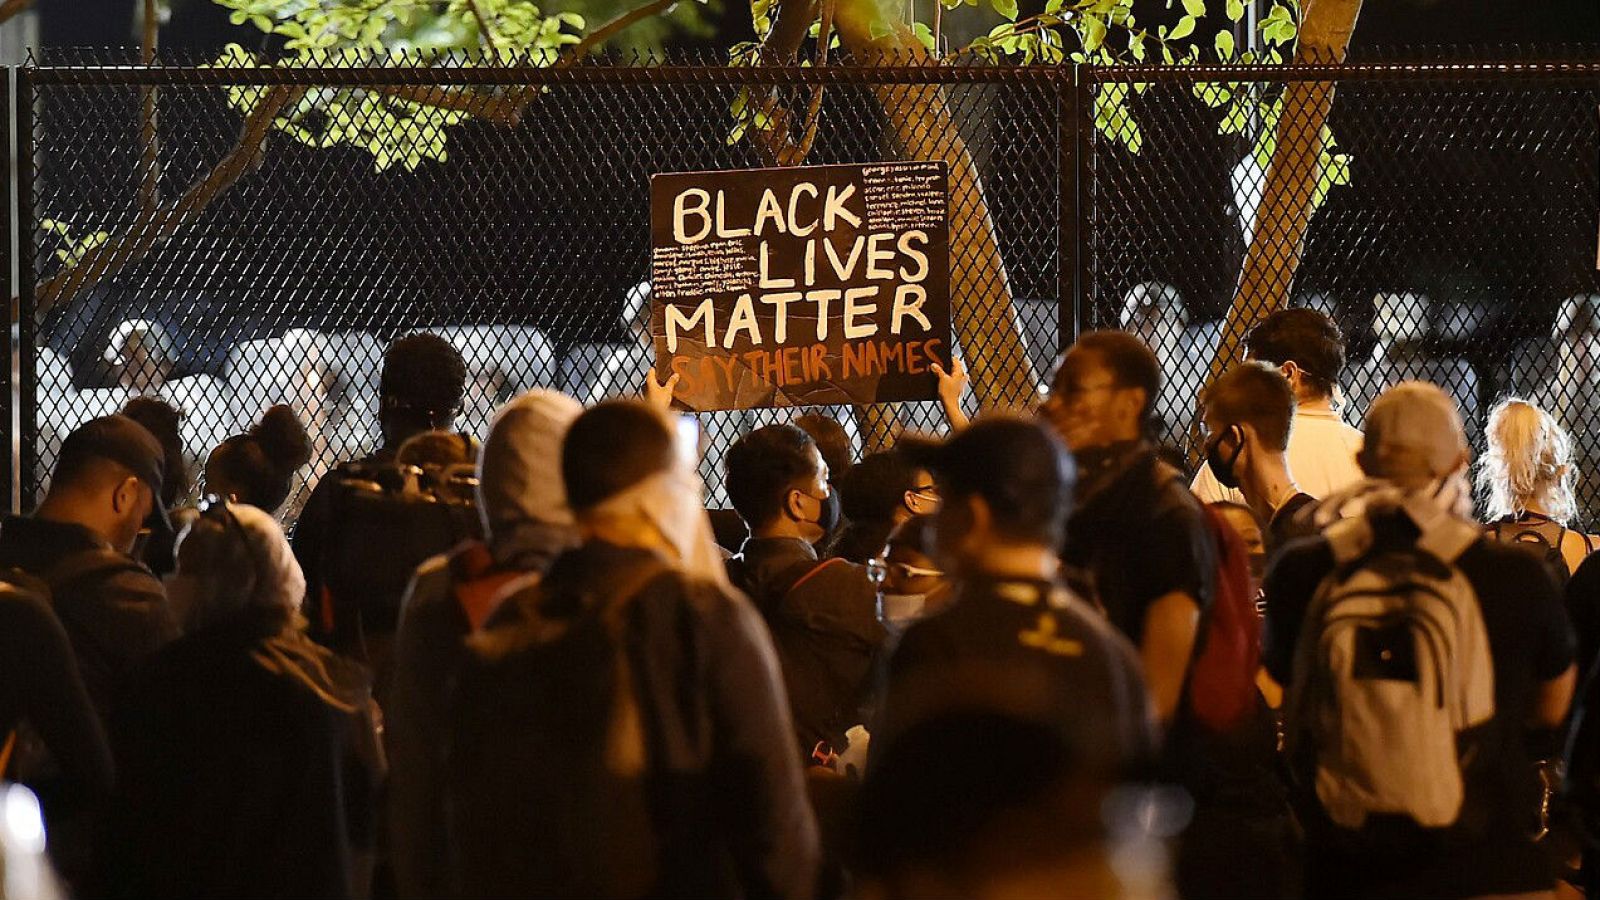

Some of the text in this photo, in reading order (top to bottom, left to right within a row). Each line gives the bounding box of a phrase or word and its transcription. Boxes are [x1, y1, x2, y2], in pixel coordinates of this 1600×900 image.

[673, 182, 863, 244] BLACK
[759, 230, 929, 289] LIVES
[665, 284, 932, 353] MATTER
[672, 339, 943, 397] SAY THEIR NAMES
